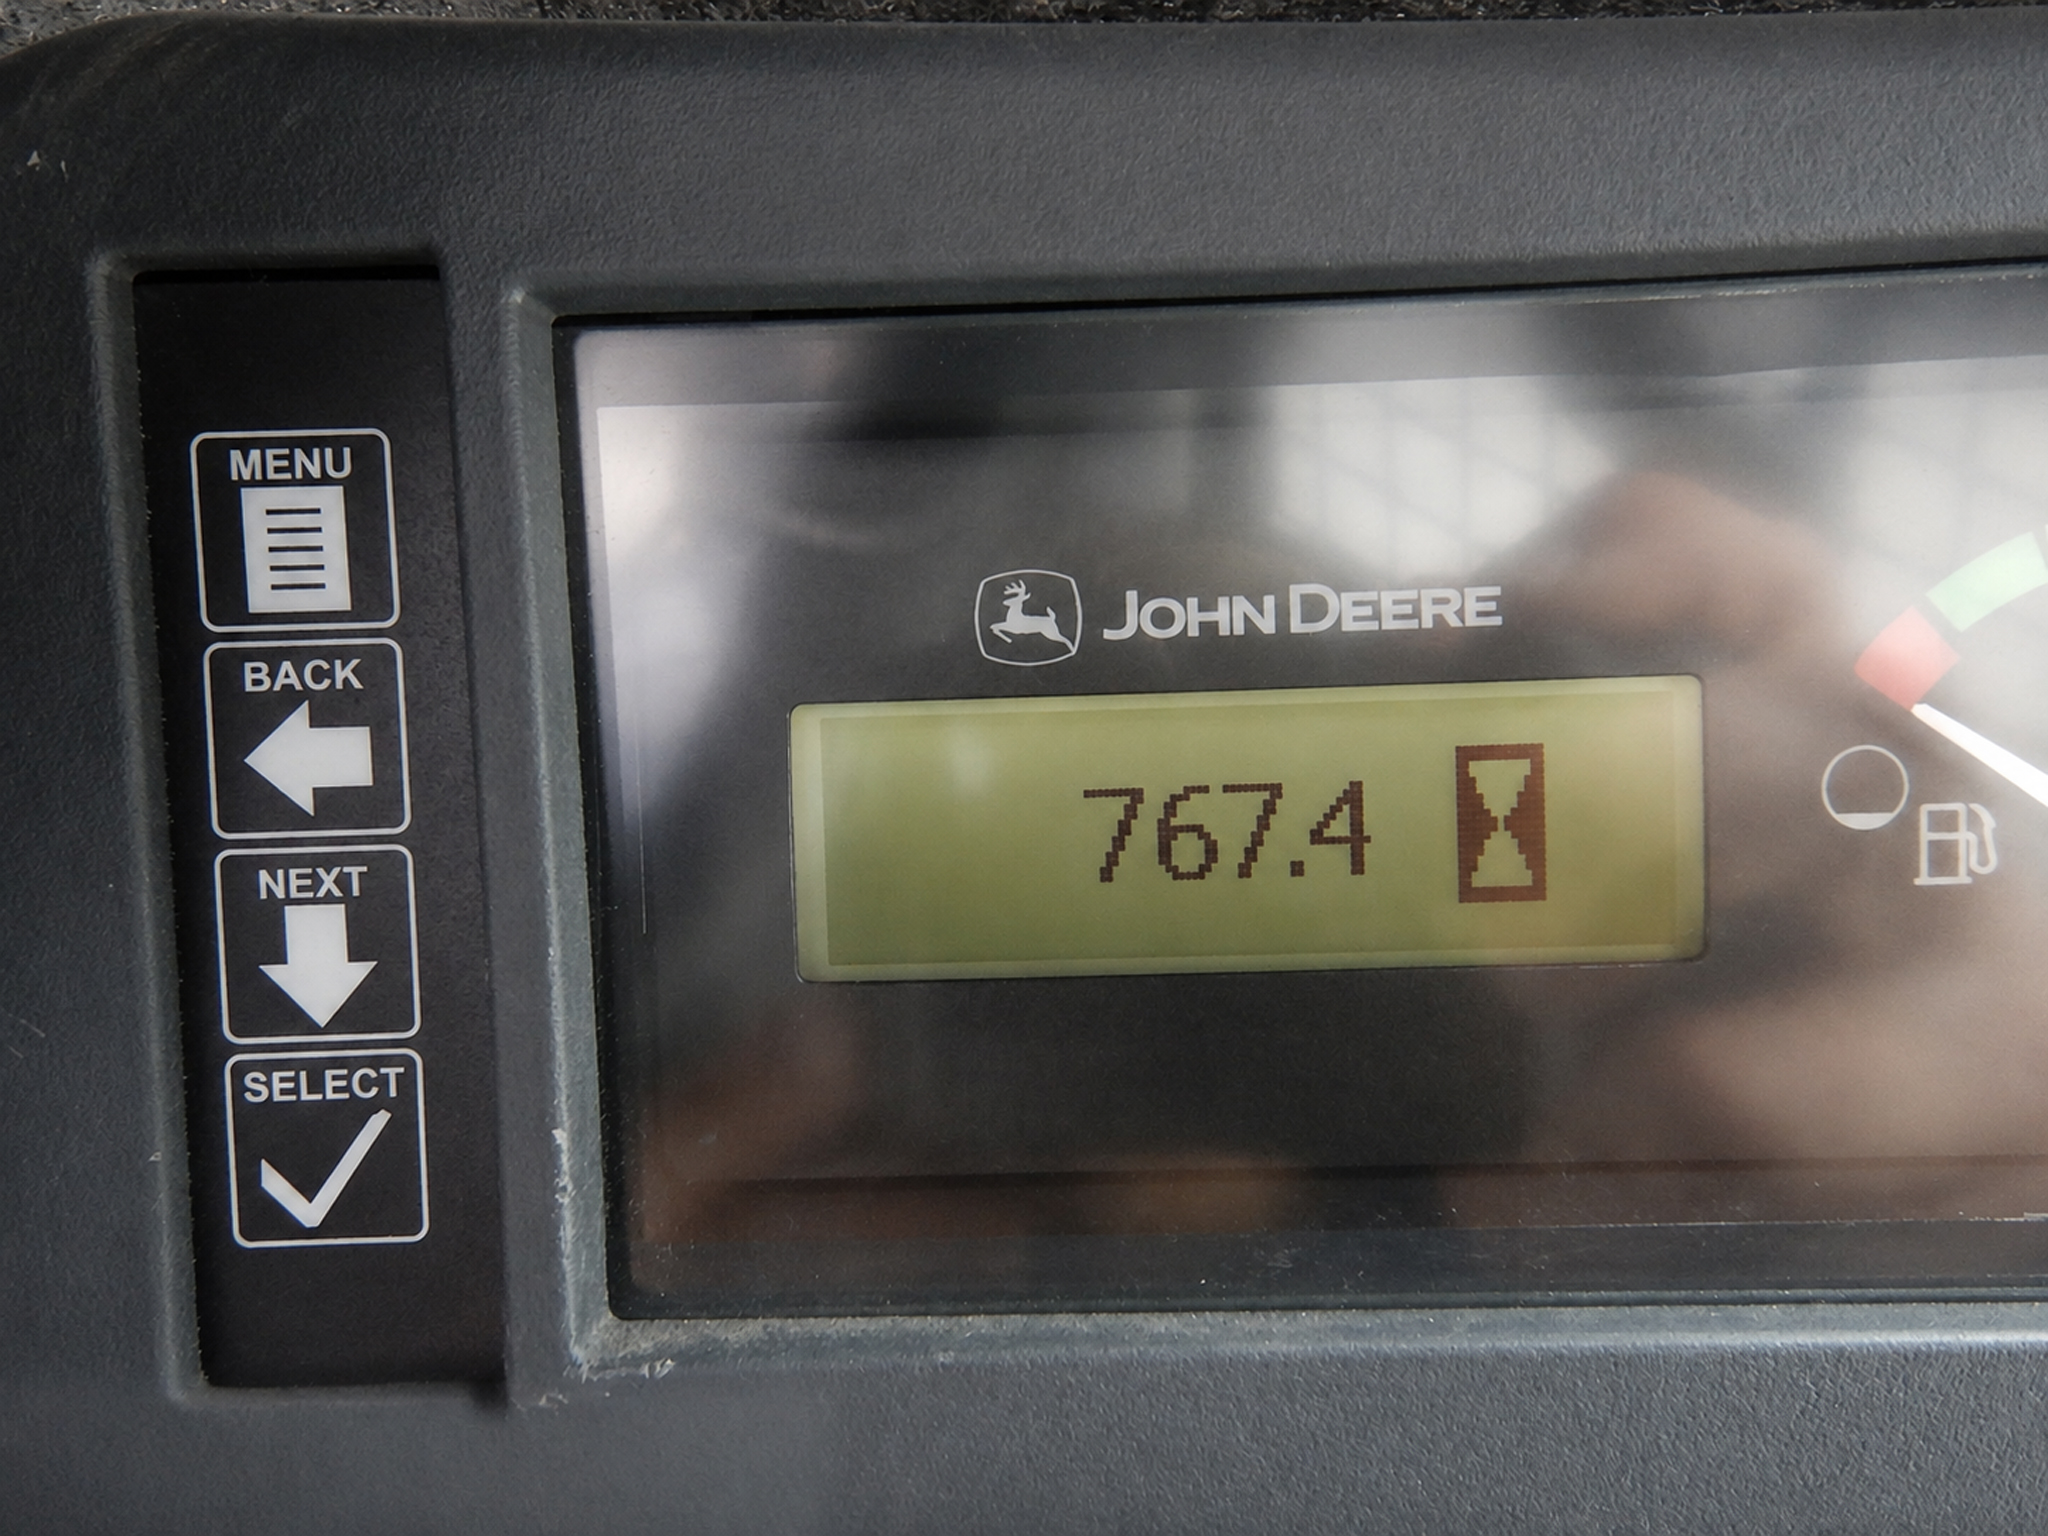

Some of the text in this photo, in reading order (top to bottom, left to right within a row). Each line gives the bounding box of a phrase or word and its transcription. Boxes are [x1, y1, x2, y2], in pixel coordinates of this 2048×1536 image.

[229, 446, 353, 481] MENU
[1103, 583, 1503, 640] JOHN DEERE
[243, 658, 364, 692] BACK
[1082, 780, 1372, 884] 767.4
[258, 865, 368, 900] NEXT
[243, 1066, 405, 1103] SELECT
